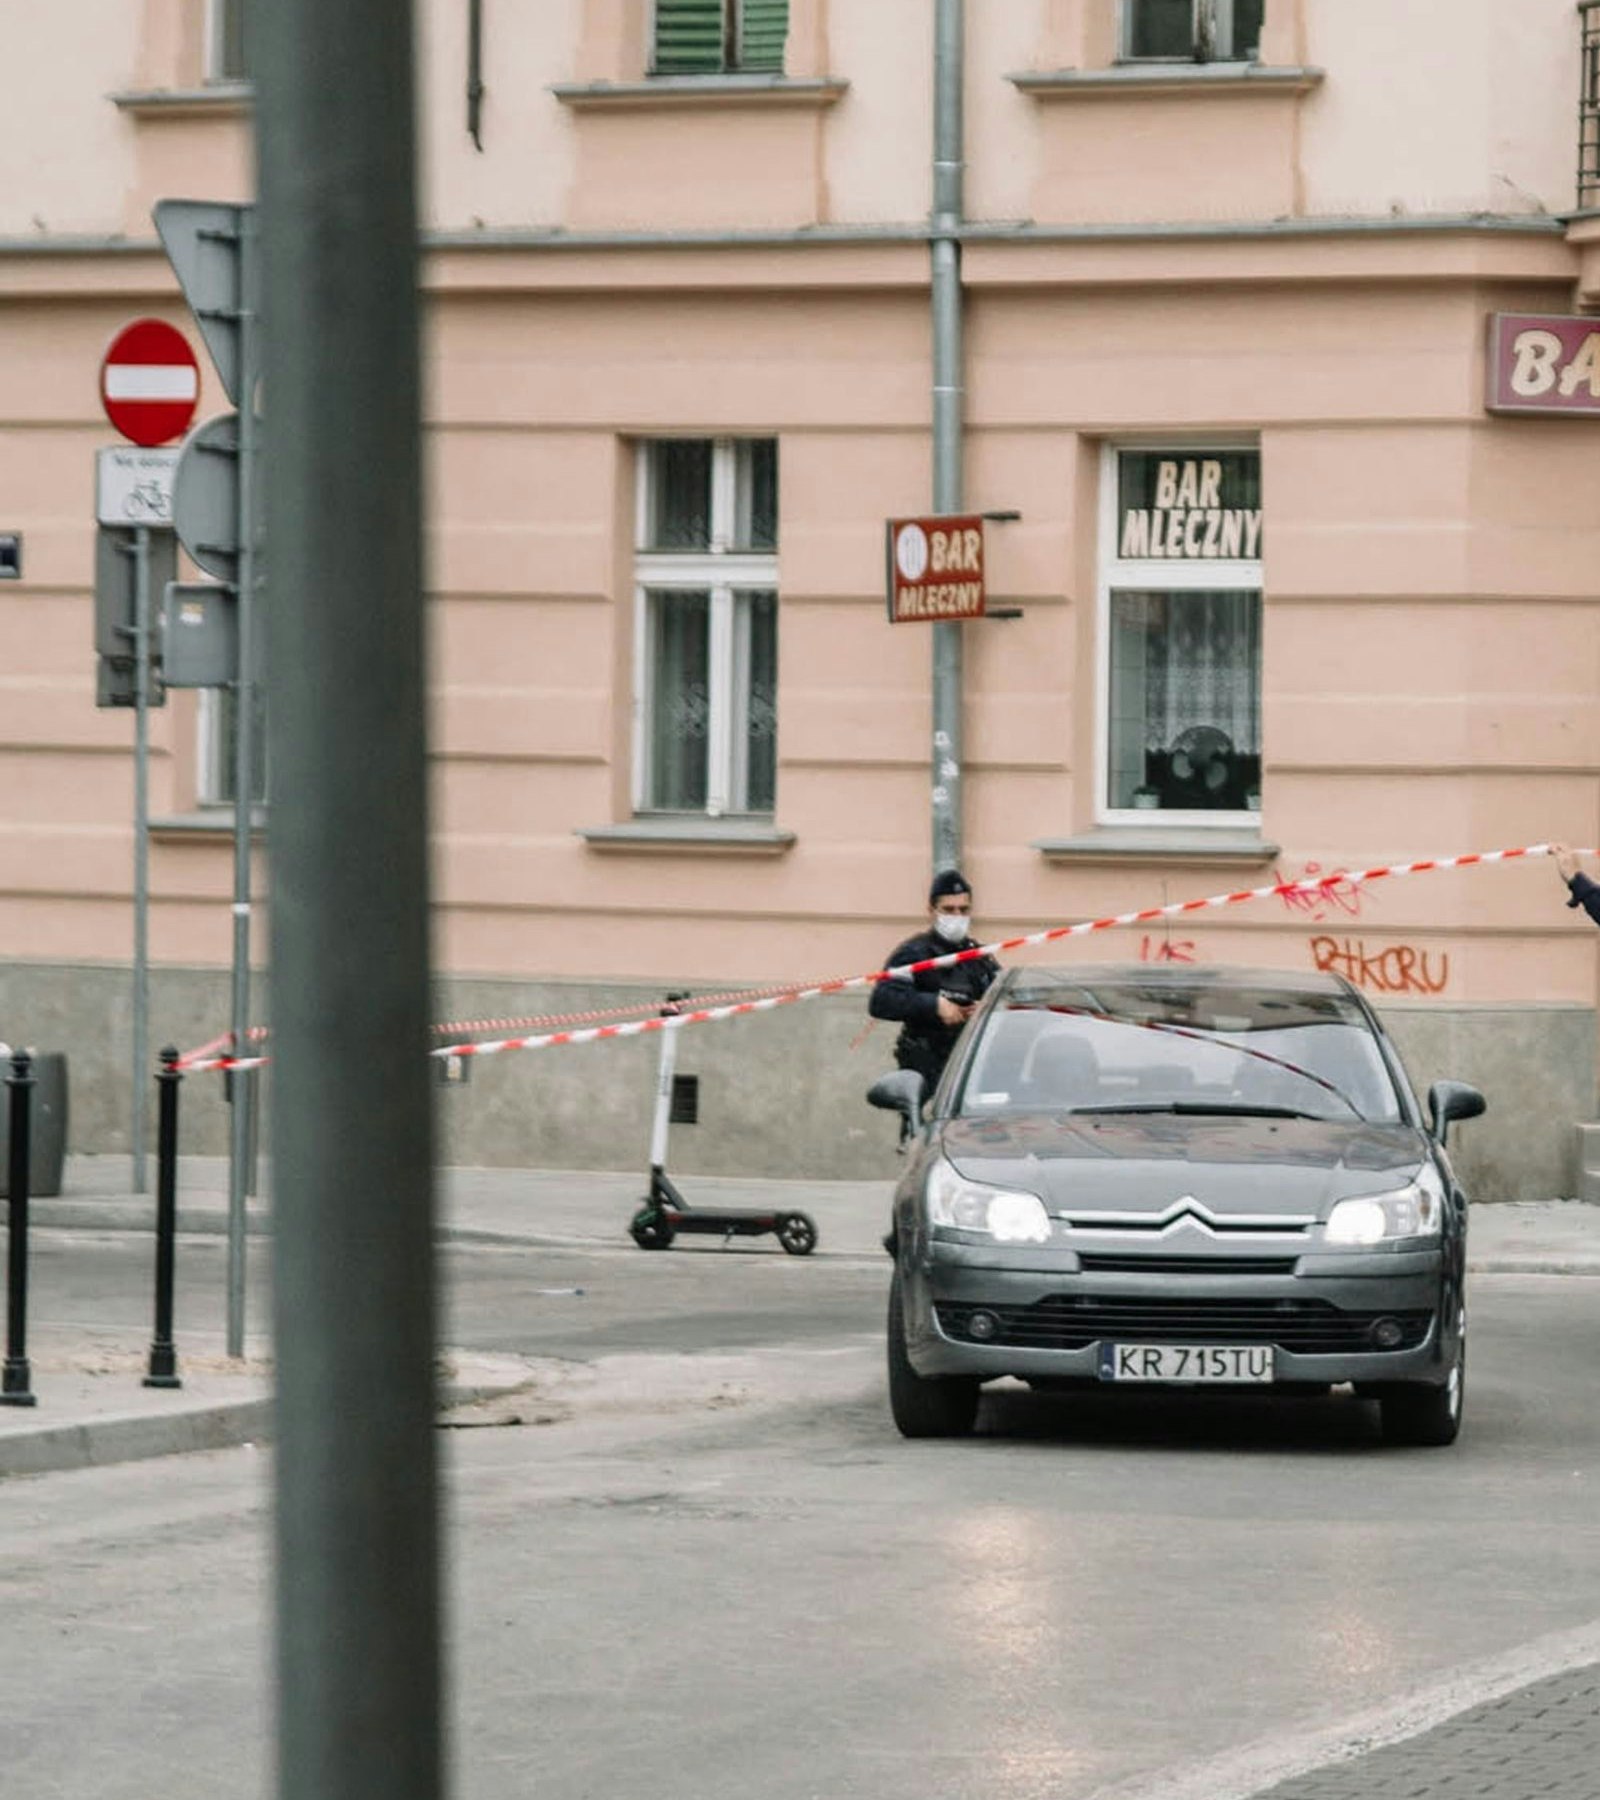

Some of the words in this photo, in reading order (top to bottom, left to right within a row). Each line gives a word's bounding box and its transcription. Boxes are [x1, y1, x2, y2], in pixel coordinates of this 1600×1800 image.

[1154, 460, 1222, 508] BAR
[930, 528, 980, 572] BAR
[1120, 509, 1262, 558] MLECZNY
[898, 582, 980, 616] MLECZNY
[1119, 1348, 1163, 1377] KR
[1173, 1348, 1267, 1378] 715TU
